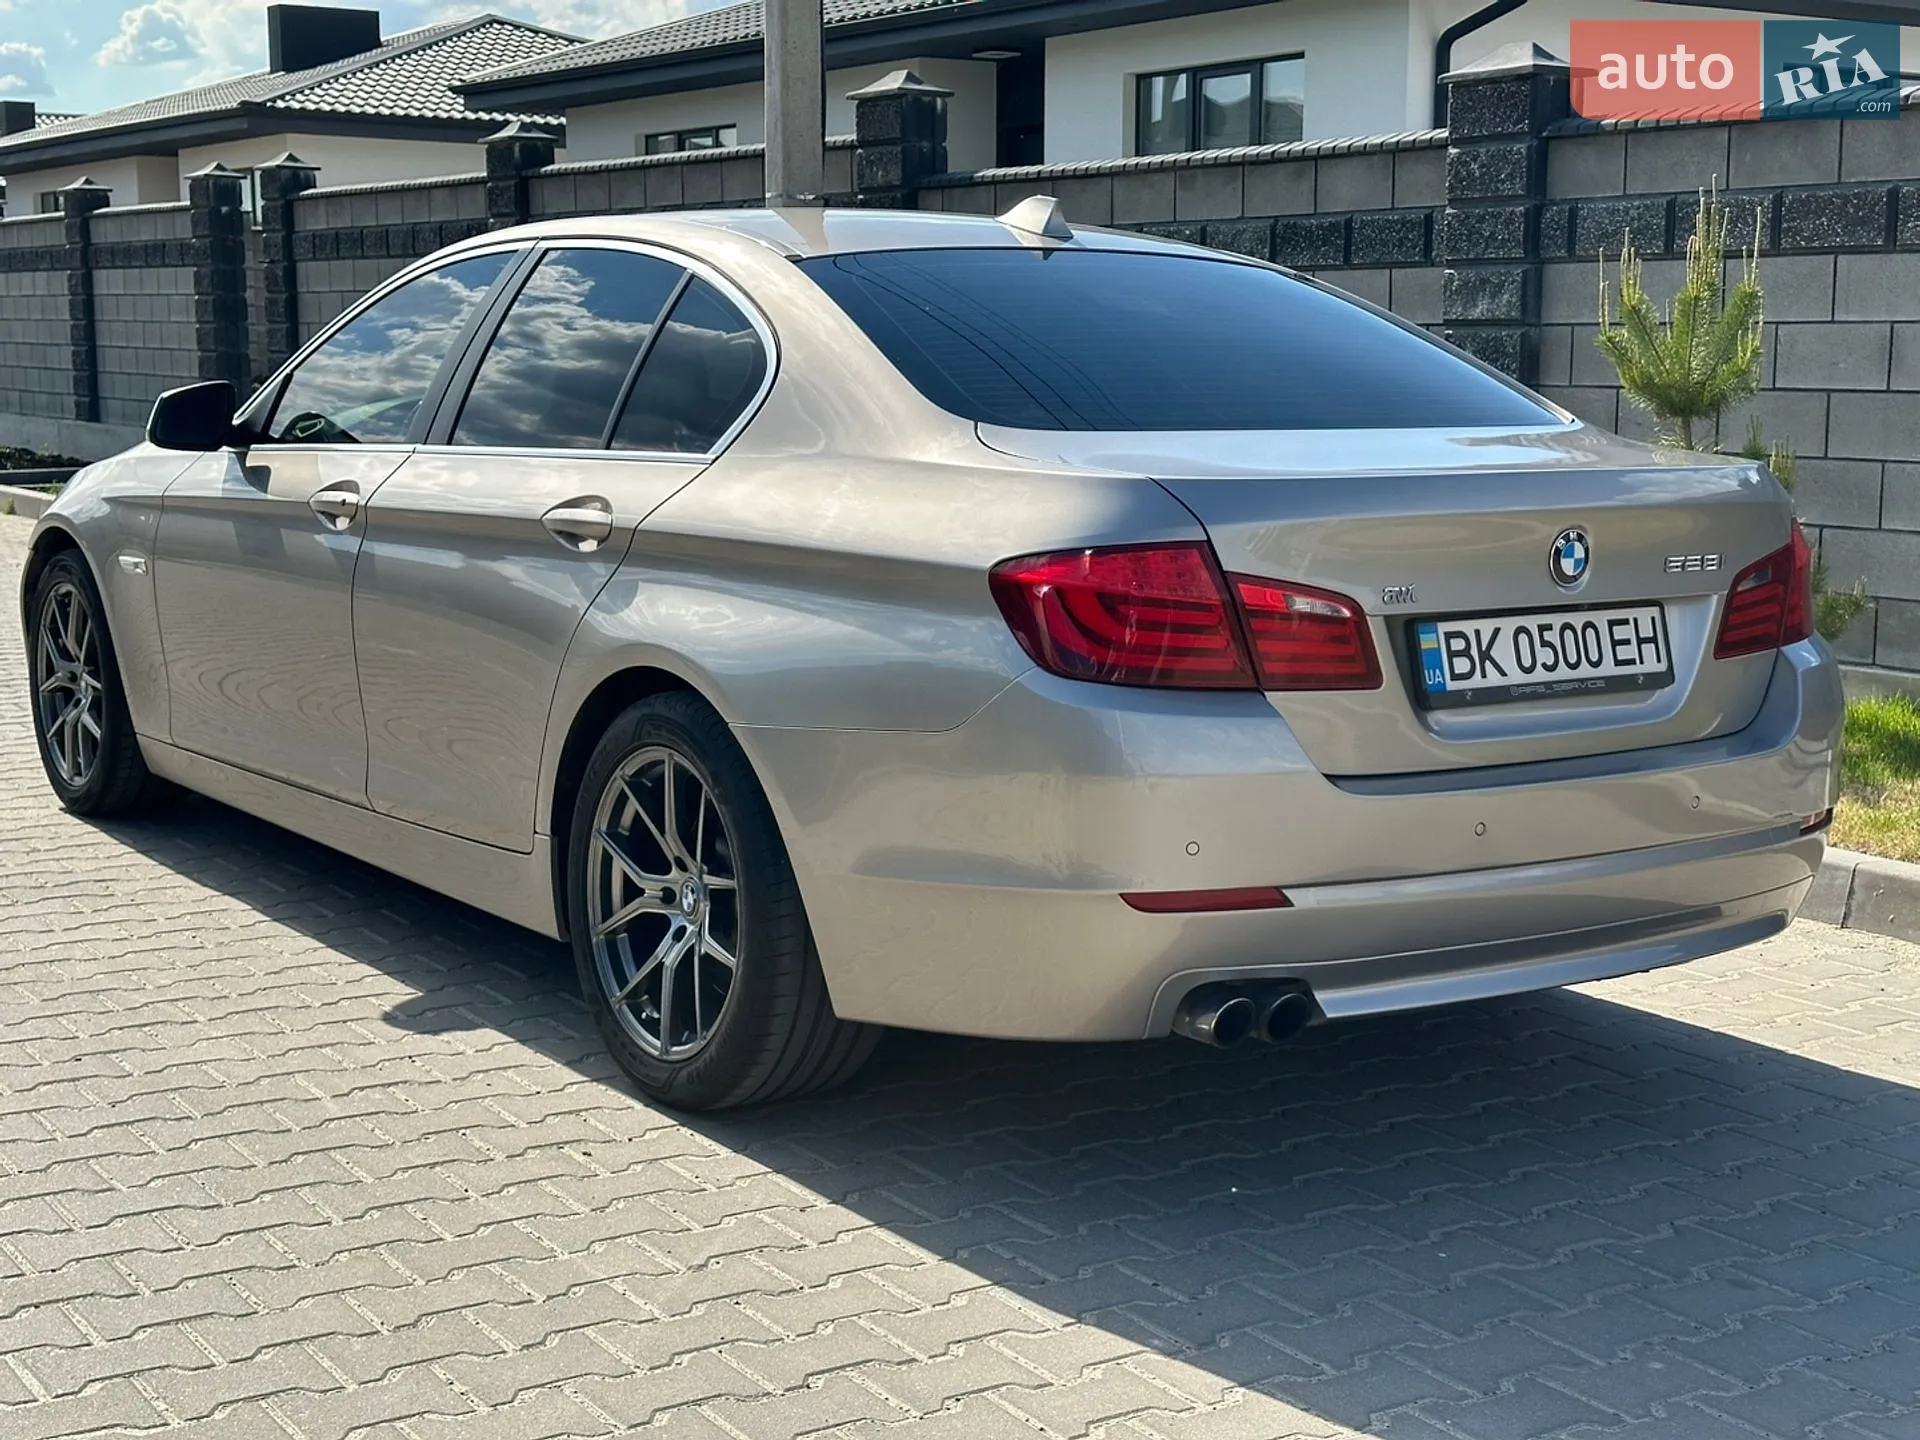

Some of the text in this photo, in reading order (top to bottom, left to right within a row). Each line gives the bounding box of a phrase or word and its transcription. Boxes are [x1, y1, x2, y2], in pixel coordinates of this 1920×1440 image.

[1443, 616, 1662, 682] BK 0500 EH
[1426, 670, 1444, 685] UA
